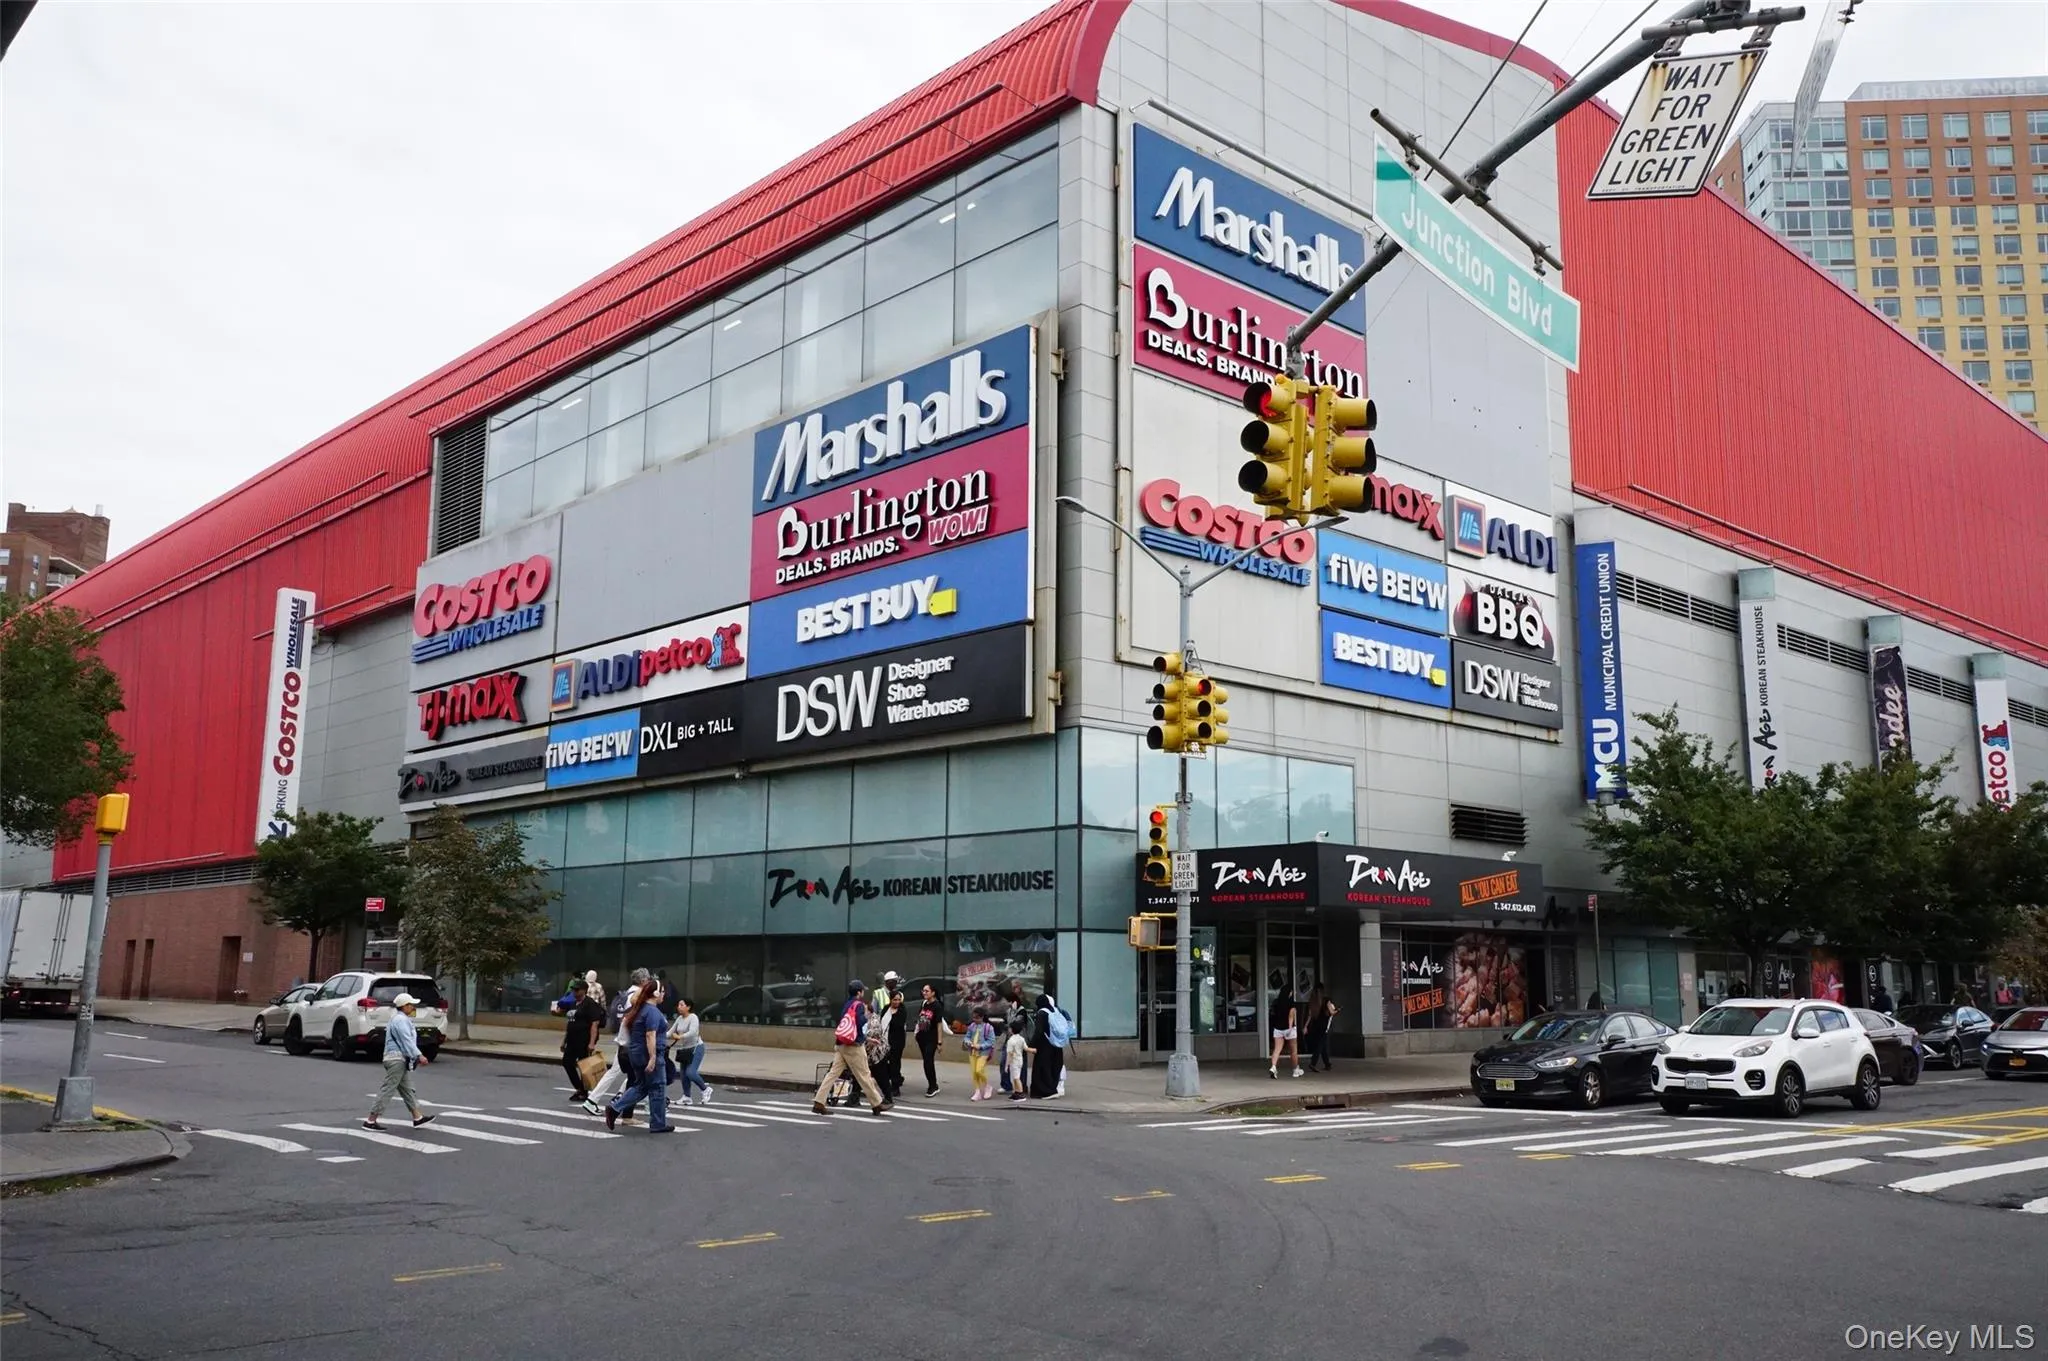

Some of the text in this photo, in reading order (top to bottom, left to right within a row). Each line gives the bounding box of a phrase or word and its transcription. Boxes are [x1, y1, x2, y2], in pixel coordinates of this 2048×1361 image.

[1663, 60, 1735, 91] WAIT
[1918, 79, 2038, 98] ALEXANDER
[1650, 93, 1712, 122] FOR
[1620, 122, 1717, 154] GREEN
[1607, 155, 1697, 187] LIGHT
[1401, 194, 1553, 338] Junction Blvd
[1148, 267, 1364, 399] Burlinton
[761, 349, 1007, 501] Marshalls
[777, 469, 989, 561] Burlington
[928, 504, 990, 547] WOW!
[1140, 478, 1316, 565] COSTCO
[776, 535, 900, 586] DEALS. BRANDS.
[1198, 539, 1312, 587] WHOLESALE
[1486, 517, 1558, 574] ALDI
[1326, 552, 1379, 593] five
[412, 554, 552, 638] COSTCO
[796, 574, 940, 644] BEST BUY
[286, 596, 300, 669] WHOLESALE
[448, 603, 546, 652] WHOLESALE
[1476, 591, 1546, 650] BBQ
[1753, 604, 1767, 667] STEAKHOUSE
[577, 636, 713, 700] ALDI petco
[888, 655, 955, 682] Designer
[1333, 631, 1436, 680] BEST BUY
[1592, 552, 1621, 789] MCU MUNICIPAL CREDIT UNION
[776, 665, 884, 743] DSW
[887, 682, 927, 703] Shoe
[1463, 660, 1521, 704] DSW
[1757, 667, 1769, 707] KOREAN
[272, 671, 302, 777] COSTCO
[887, 696, 970, 725] Warehouse
[545, 741, 579, 770] five
[640, 721, 679, 756] DXL
[677, 725, 696, 741] BIG
[708, 717, 735, 735] TALL
[883, 876, 942, 897] KOREAN
[946, 869, 1055, 895] STEAKHOUSE
[1174, 871, 1195, 880] GREEN
[1174, 880, 1194, 889] LIGHT
[1211, 892, 1308, 903] KOREAN STEAKHOUSE
[1461, 882, 1474, 902] ALL
[1490, 877, 1505, 895] CAN
[1506, 874, 1518, 892] EAT
[1347, 892, 1433, 906] KOREAN STEAKHOUSE
